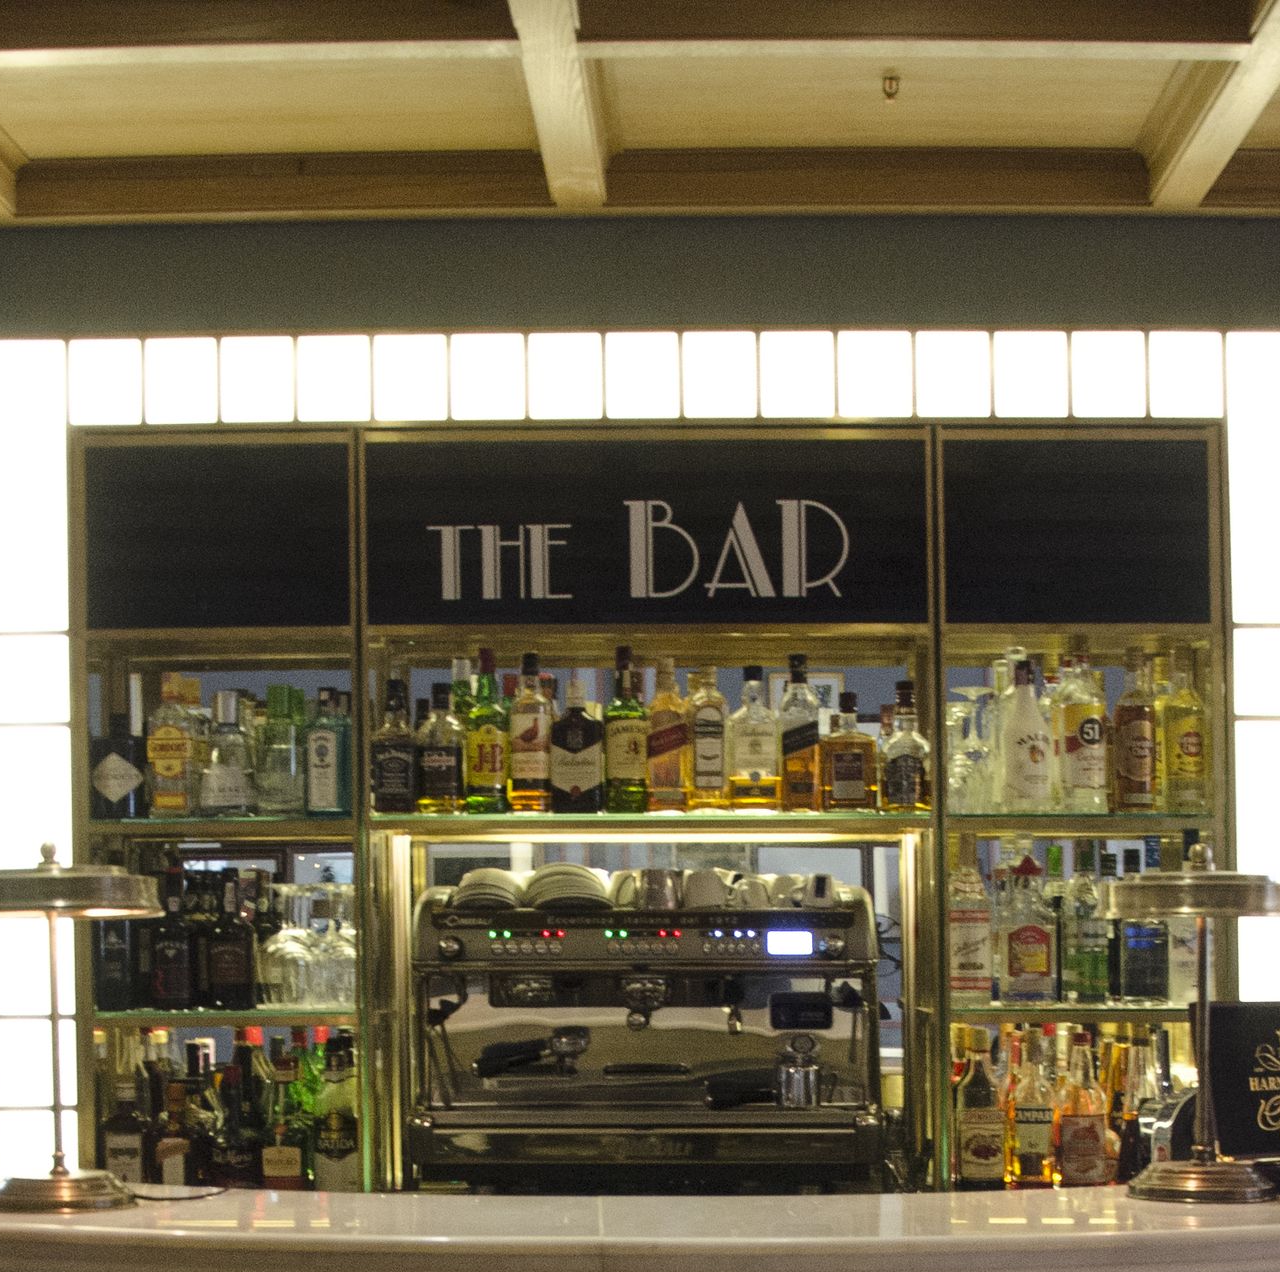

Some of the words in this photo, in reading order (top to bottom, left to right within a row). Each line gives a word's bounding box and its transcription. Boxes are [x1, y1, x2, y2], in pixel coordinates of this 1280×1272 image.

[426, 524, 573, 600] THE
[623, 499, 850, 598] BAR
[1082, 723, 1100, 740] 51
